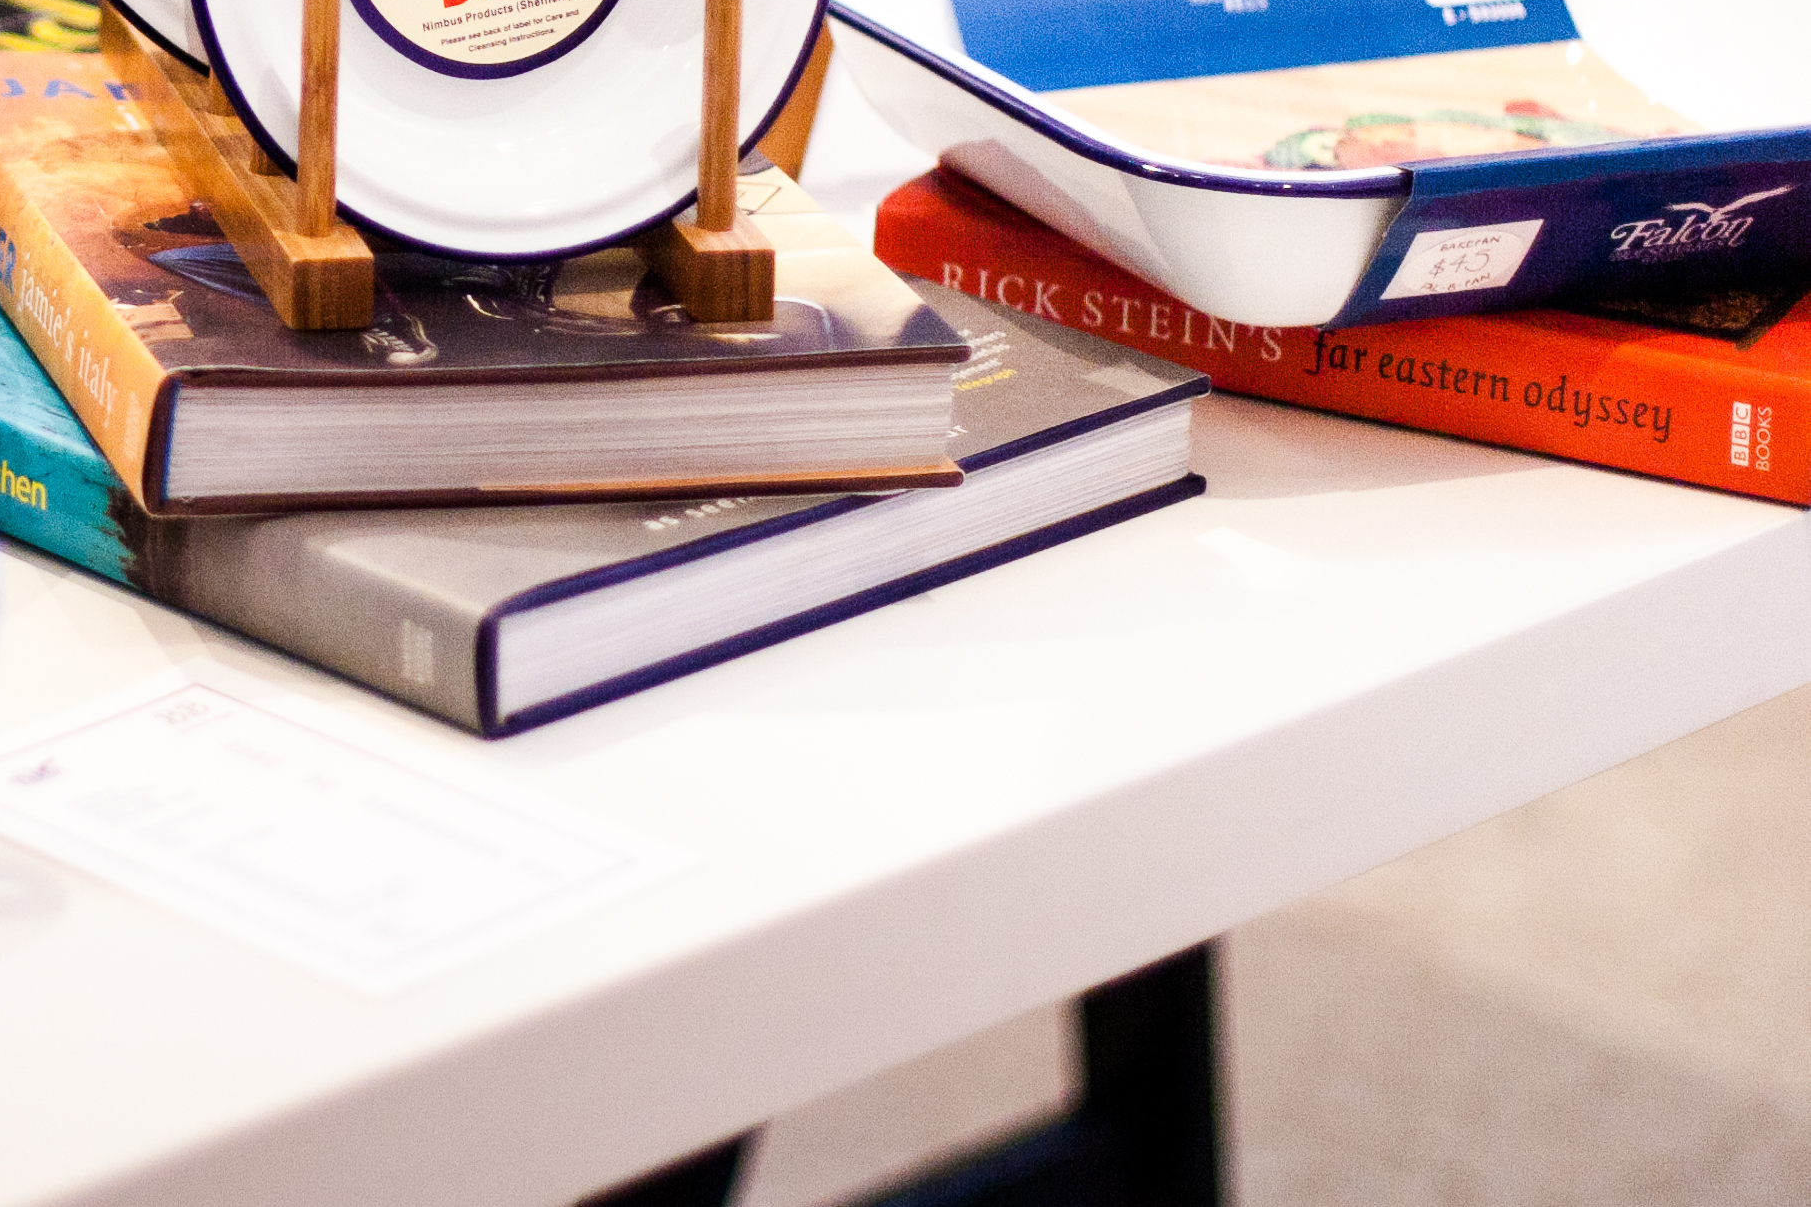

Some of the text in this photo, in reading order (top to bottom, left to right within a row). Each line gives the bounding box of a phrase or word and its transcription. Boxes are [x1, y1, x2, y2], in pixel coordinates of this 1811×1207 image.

[422, 15, 463, 32] Nimbus
[465, 4, 514, 23] Products
[440, 34, 467, 46] Please
[468, 30, 482, 40] see
[483, 26, 502, 37] back
[503, 23, 512, 33] of
[533, 16, 544, 25] for
[545, 12, 564, 23] Care
[468, 37, 508, 53] Cleansing
[1609, 214, 1754, 251] Falcon
[1428, 248, 1492, 278] $45
[941, 261, 1674, 444] RICK STEIN'S far eastern odyssey
[77, 330, 119, 429] italy
[1732, 403, 1750, 465] BBC
[1755, 406, 1773, 472] BOOKS
